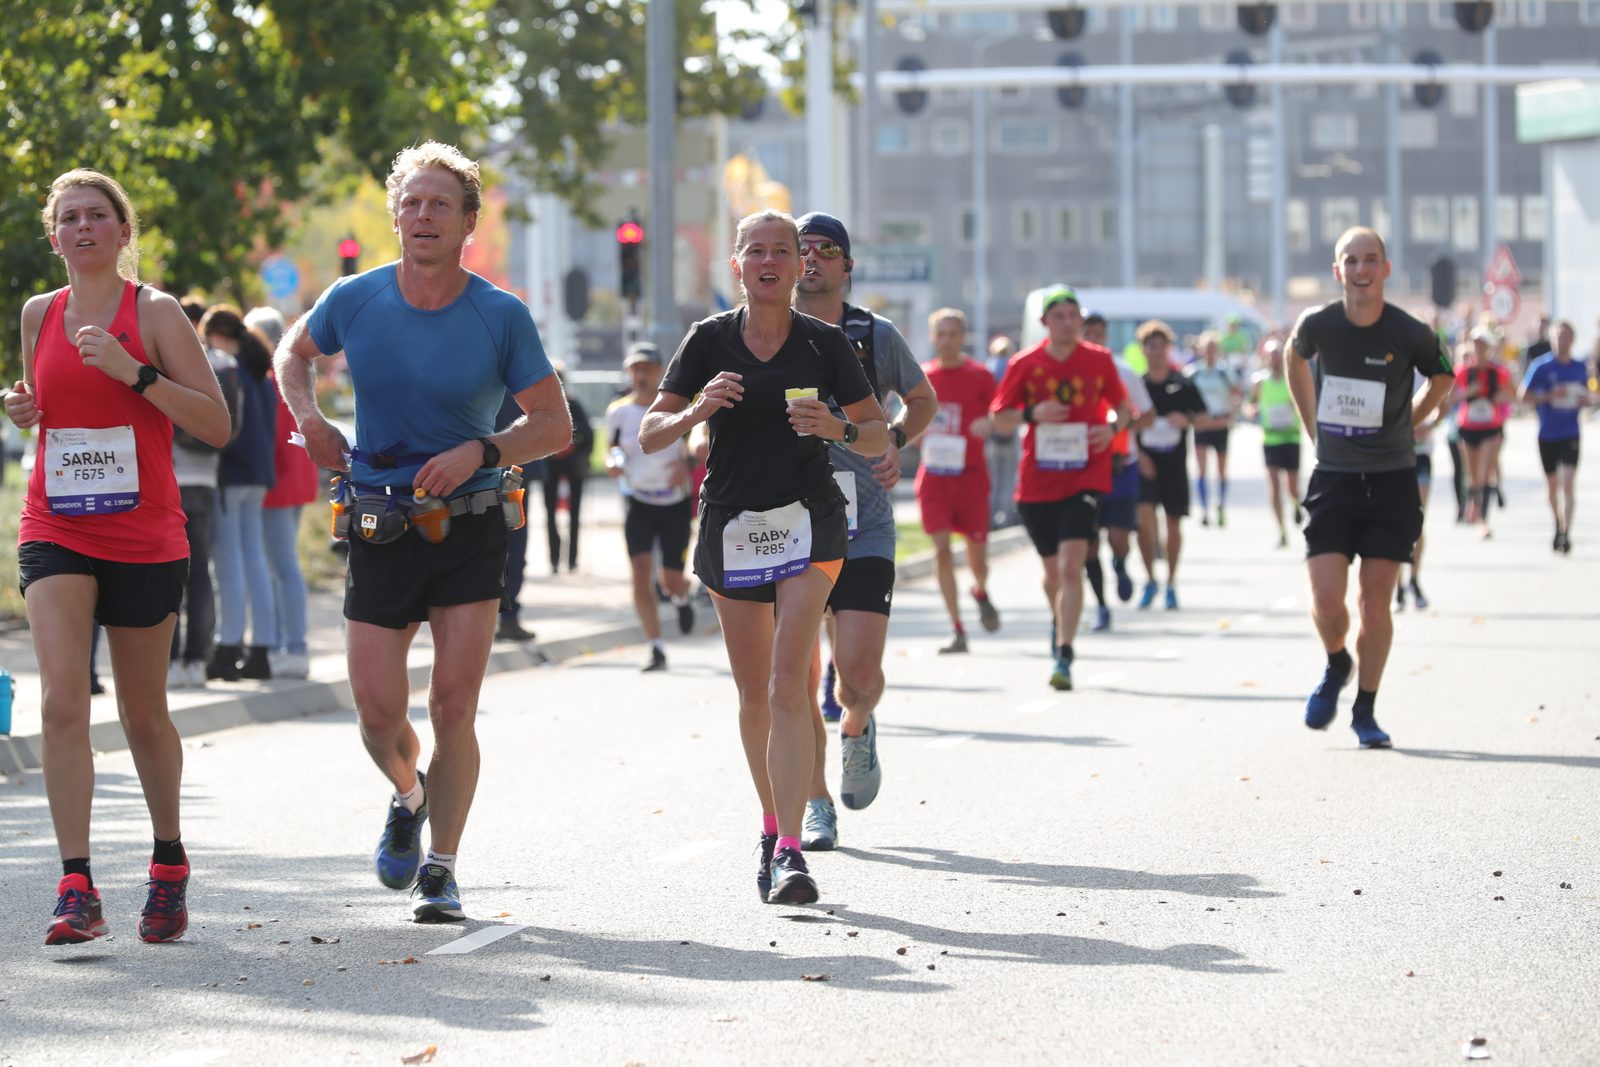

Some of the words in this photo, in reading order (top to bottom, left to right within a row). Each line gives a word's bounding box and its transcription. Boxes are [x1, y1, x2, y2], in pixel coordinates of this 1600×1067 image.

[1337, 394, 1366, 407] STAN
[62, 451, 115, 467] SARAH
[74, 468, 105, 480] F675
[748, 529, 790, 544] GABY
[755, 543, 785, 555] F285
[729, 574, 762, 582] EINDHOVEN
